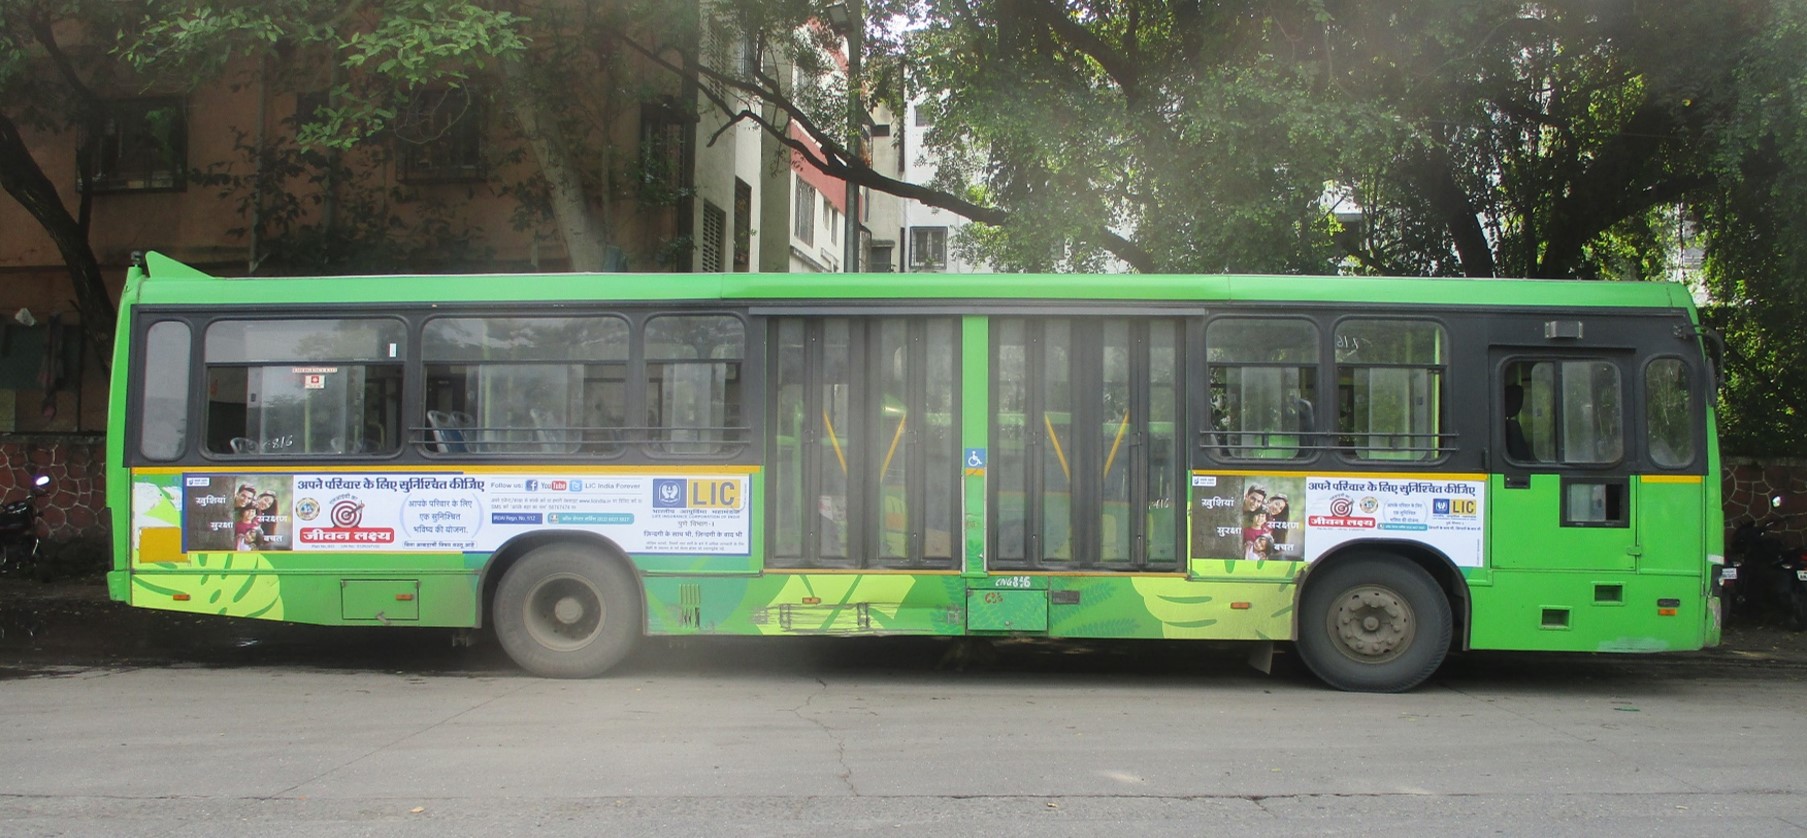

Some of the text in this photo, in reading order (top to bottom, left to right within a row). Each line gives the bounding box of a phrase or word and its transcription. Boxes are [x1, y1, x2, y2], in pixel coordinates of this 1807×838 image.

[298, 477, 485, 493] अपने परिवार के लिए सुनिश्चित कीजिए
[491, 481, 511, 489] Follow
[1308, 480, 1476, 497] अपने परिवार के लिए सुनिश्चित कीजिए
[693, 481, 735, 506] LIC
[452, 498, 458, 507] के
[1453, 500, 1474, 514] LIC
[257, 513, 289, 523] संरक्षण
[1310, 517, 1374, 527] जीवन लक्ष्य
[210, 520, 234, 531] सुरक्षा
[435, 523, 444, 533] की
[1266, 519, 1299, 529] संरक्षण
[303, 528, 392, 542] जीवन लक्ष्य
[1217, 526, 1242, 537] सुरक्षा
[263, 534, 283, 542] बचत
[1274, 543, 1294, 551] बचत
